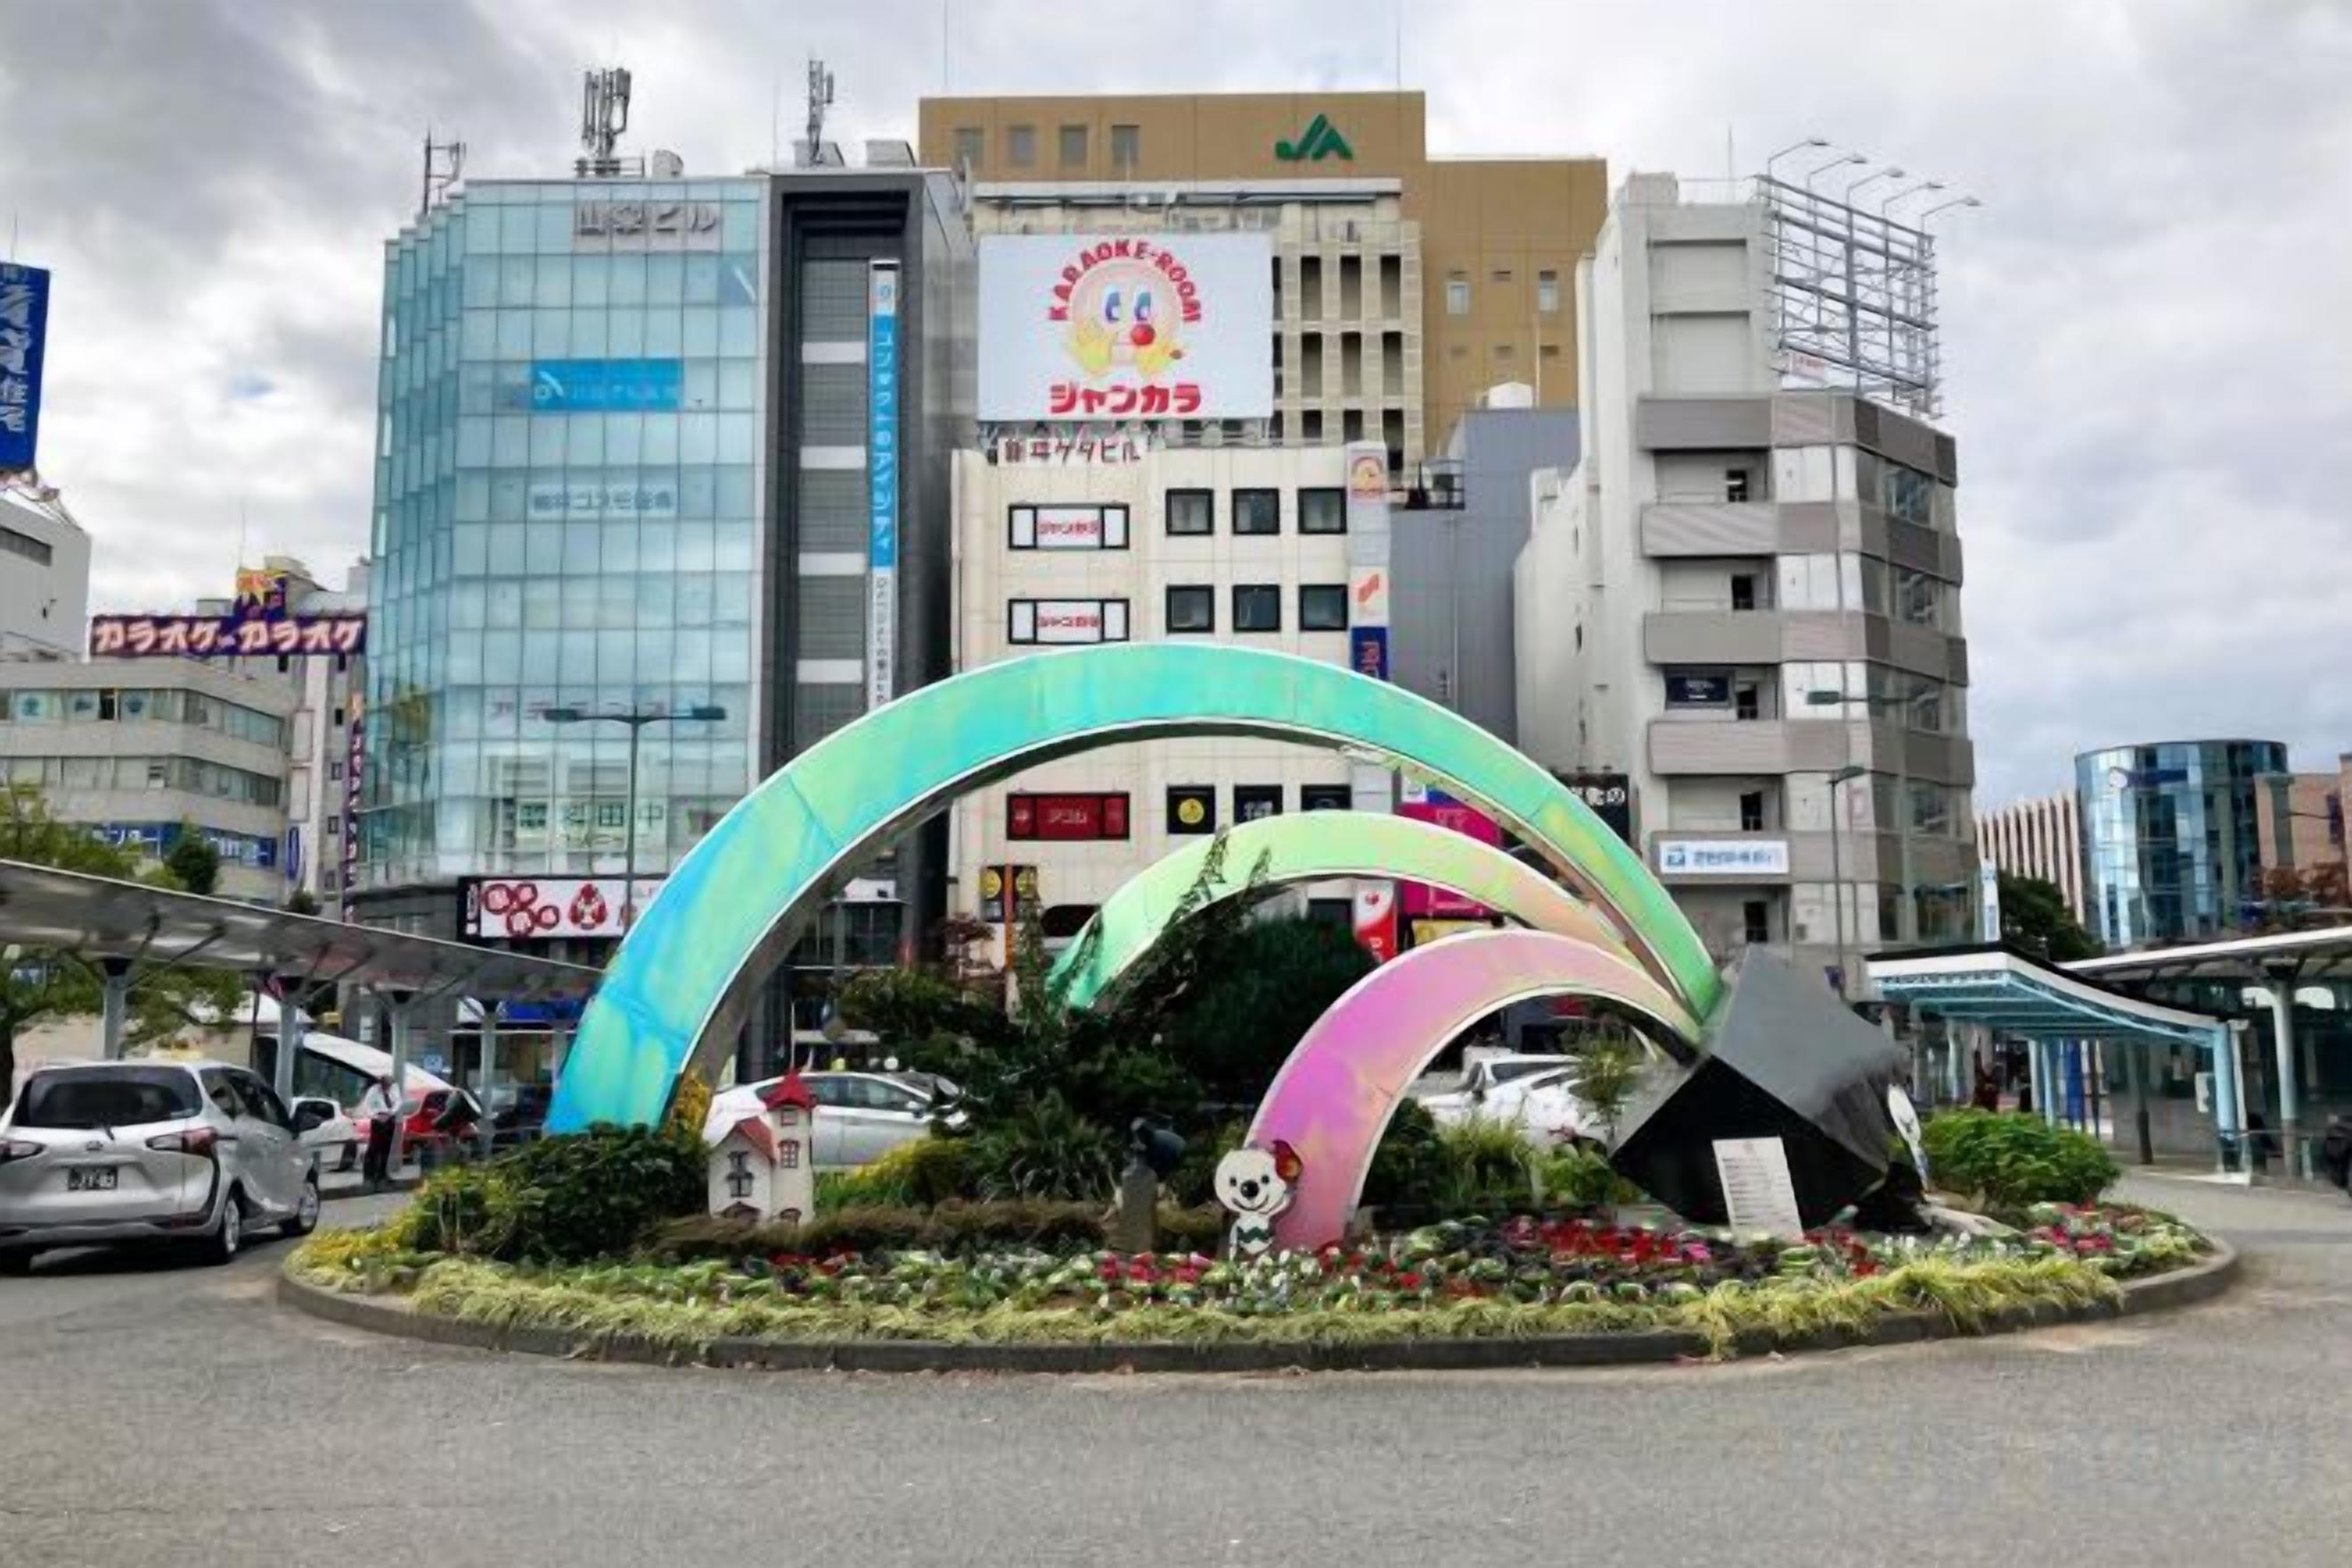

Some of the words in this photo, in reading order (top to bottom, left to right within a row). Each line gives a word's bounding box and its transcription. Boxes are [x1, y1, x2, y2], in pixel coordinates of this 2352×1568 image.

[1275, 114, 1353, 161] JA
[1049, 382, 1201, 414] ジャンカラ
